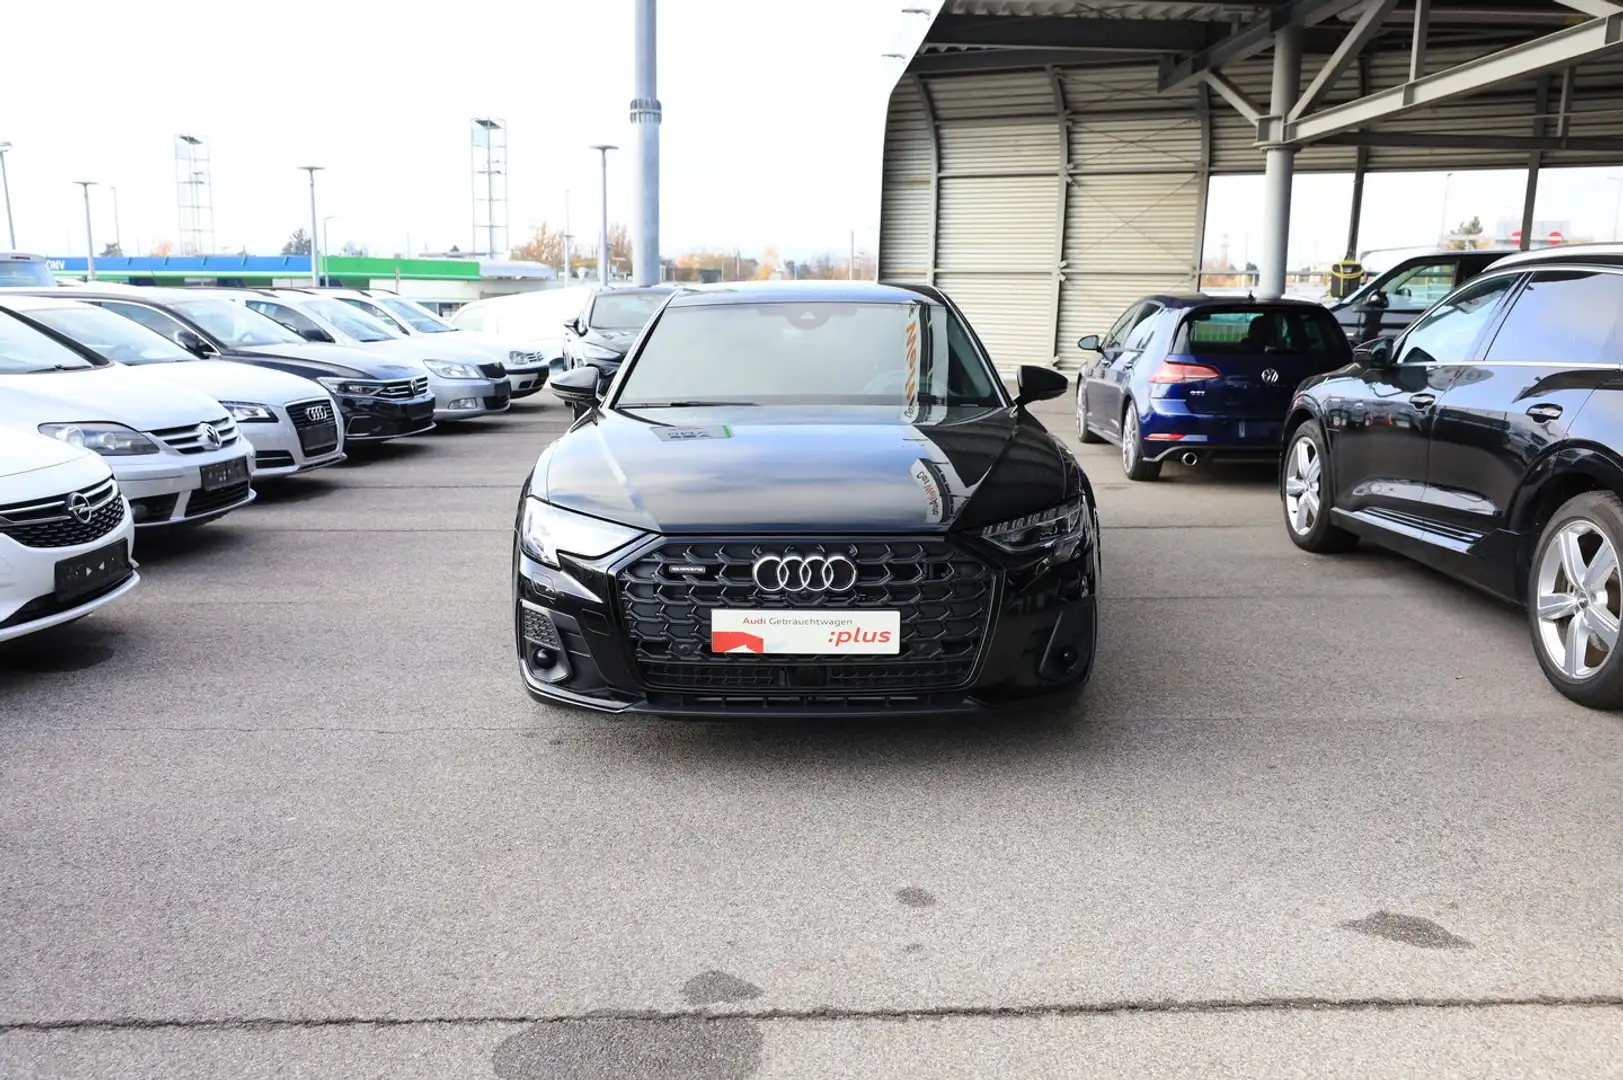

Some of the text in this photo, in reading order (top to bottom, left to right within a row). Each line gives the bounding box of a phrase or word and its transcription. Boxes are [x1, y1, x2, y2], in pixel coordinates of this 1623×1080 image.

[742, 617, 853, 627] Audi Gebrauchtwagen
[828, 626, 892, 647] :plus
